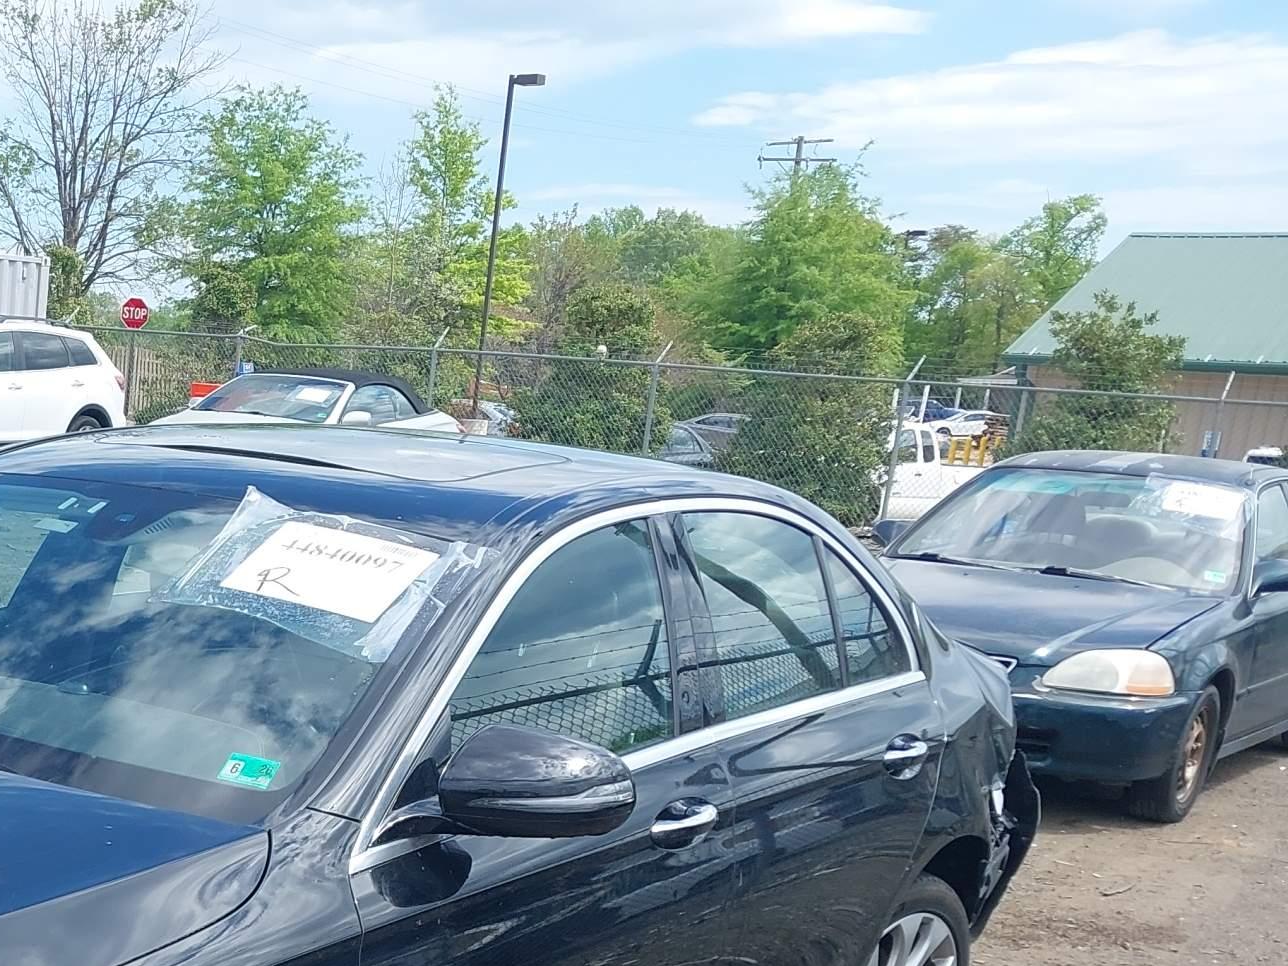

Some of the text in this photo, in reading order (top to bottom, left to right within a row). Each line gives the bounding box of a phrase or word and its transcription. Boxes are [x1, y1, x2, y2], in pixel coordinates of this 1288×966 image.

[122, 306, 148, 320] STOP
[280, 539, 405, 574] 44840097
[256, 566, 301, 597] R
[229, 762, 241, 774] 6
